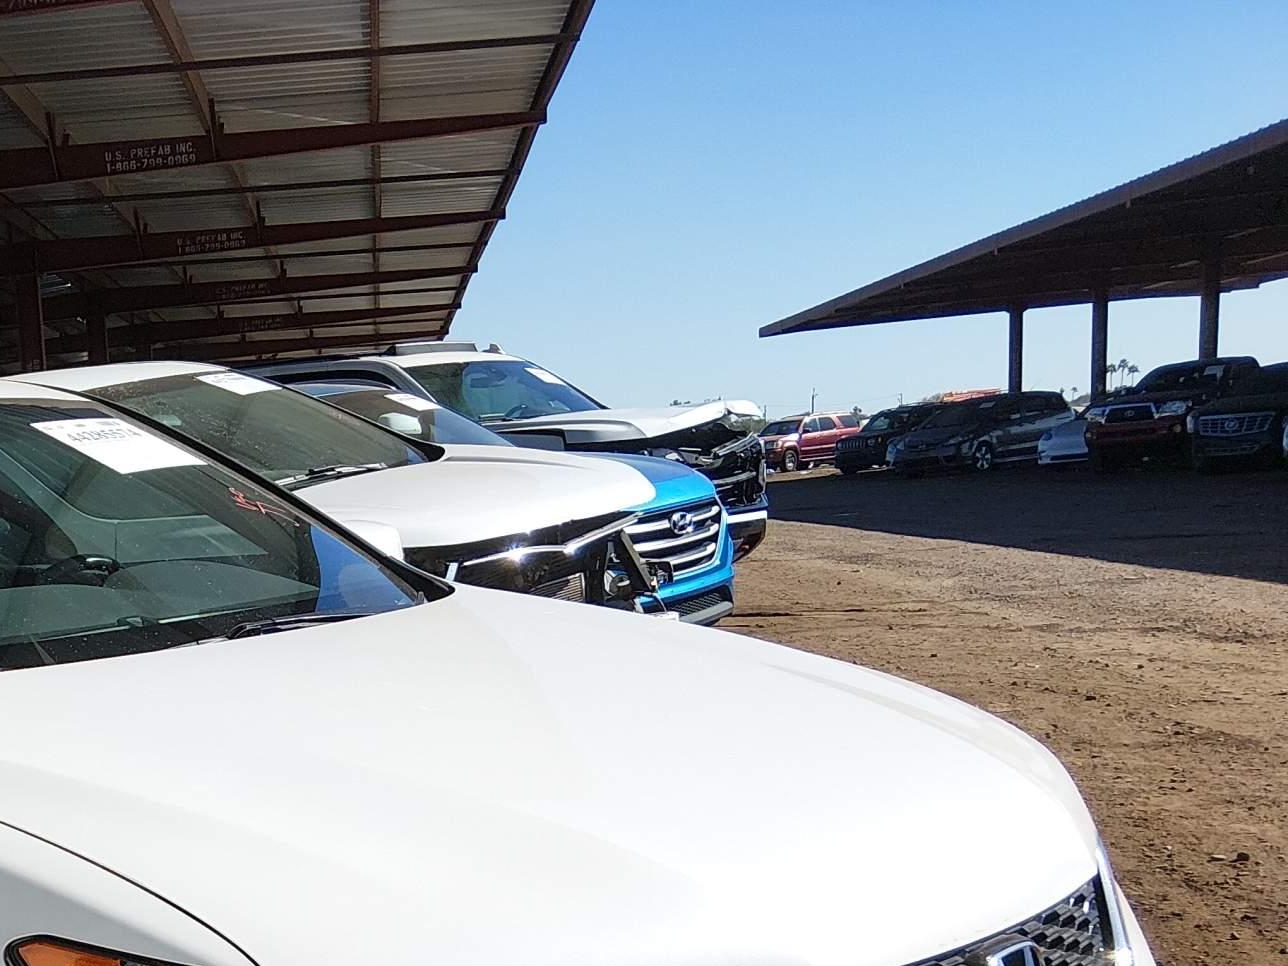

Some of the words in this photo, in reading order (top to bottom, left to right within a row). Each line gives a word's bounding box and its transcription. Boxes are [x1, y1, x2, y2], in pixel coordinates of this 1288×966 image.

[104, 150, 128, 162] U.S.
[130, 144, 171, 159] PREFAB
[174, 142, 197, 155] INC.
[66, 428, 143, 442] 44285574
